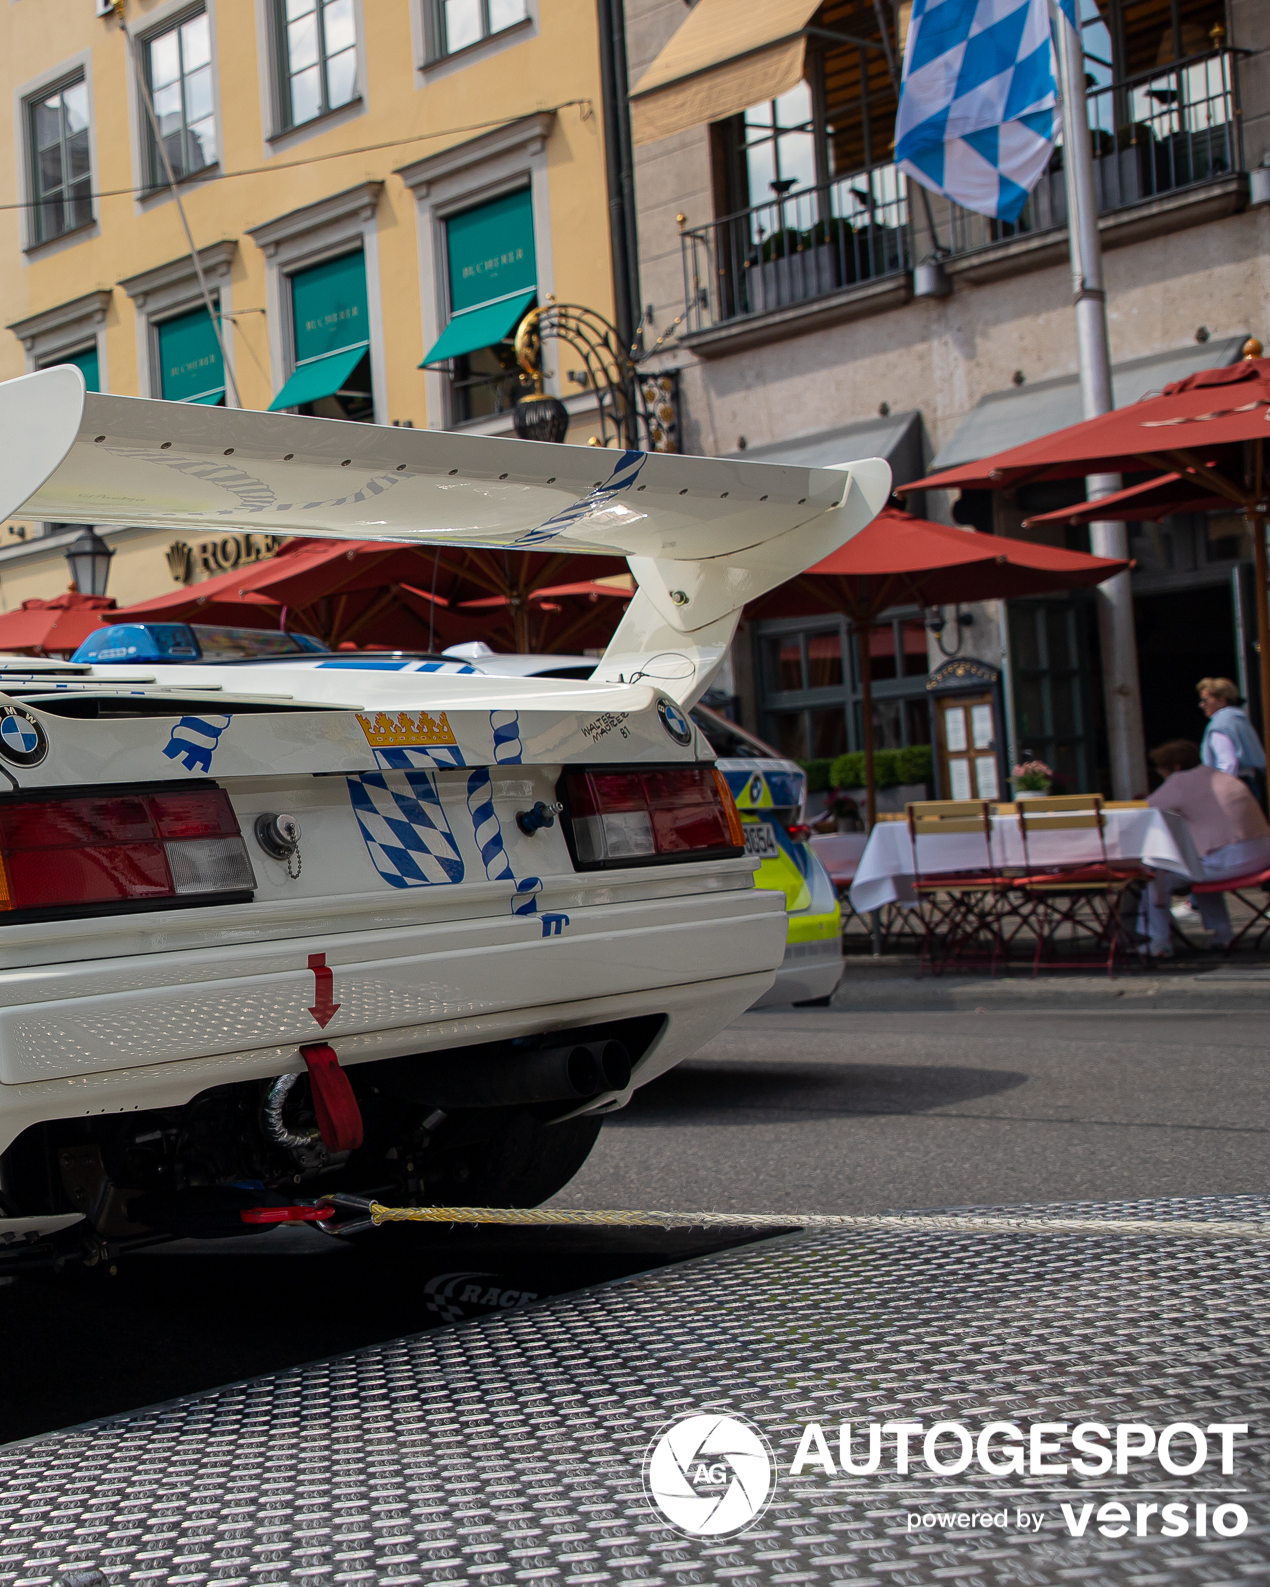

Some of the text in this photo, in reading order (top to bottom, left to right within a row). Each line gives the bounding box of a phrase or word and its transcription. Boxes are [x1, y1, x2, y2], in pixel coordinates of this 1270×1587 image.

[581, 712, 615, 738] WALTER
[592, 712, 630, 744] MAURER
[619, 725, 631, 739] 81
